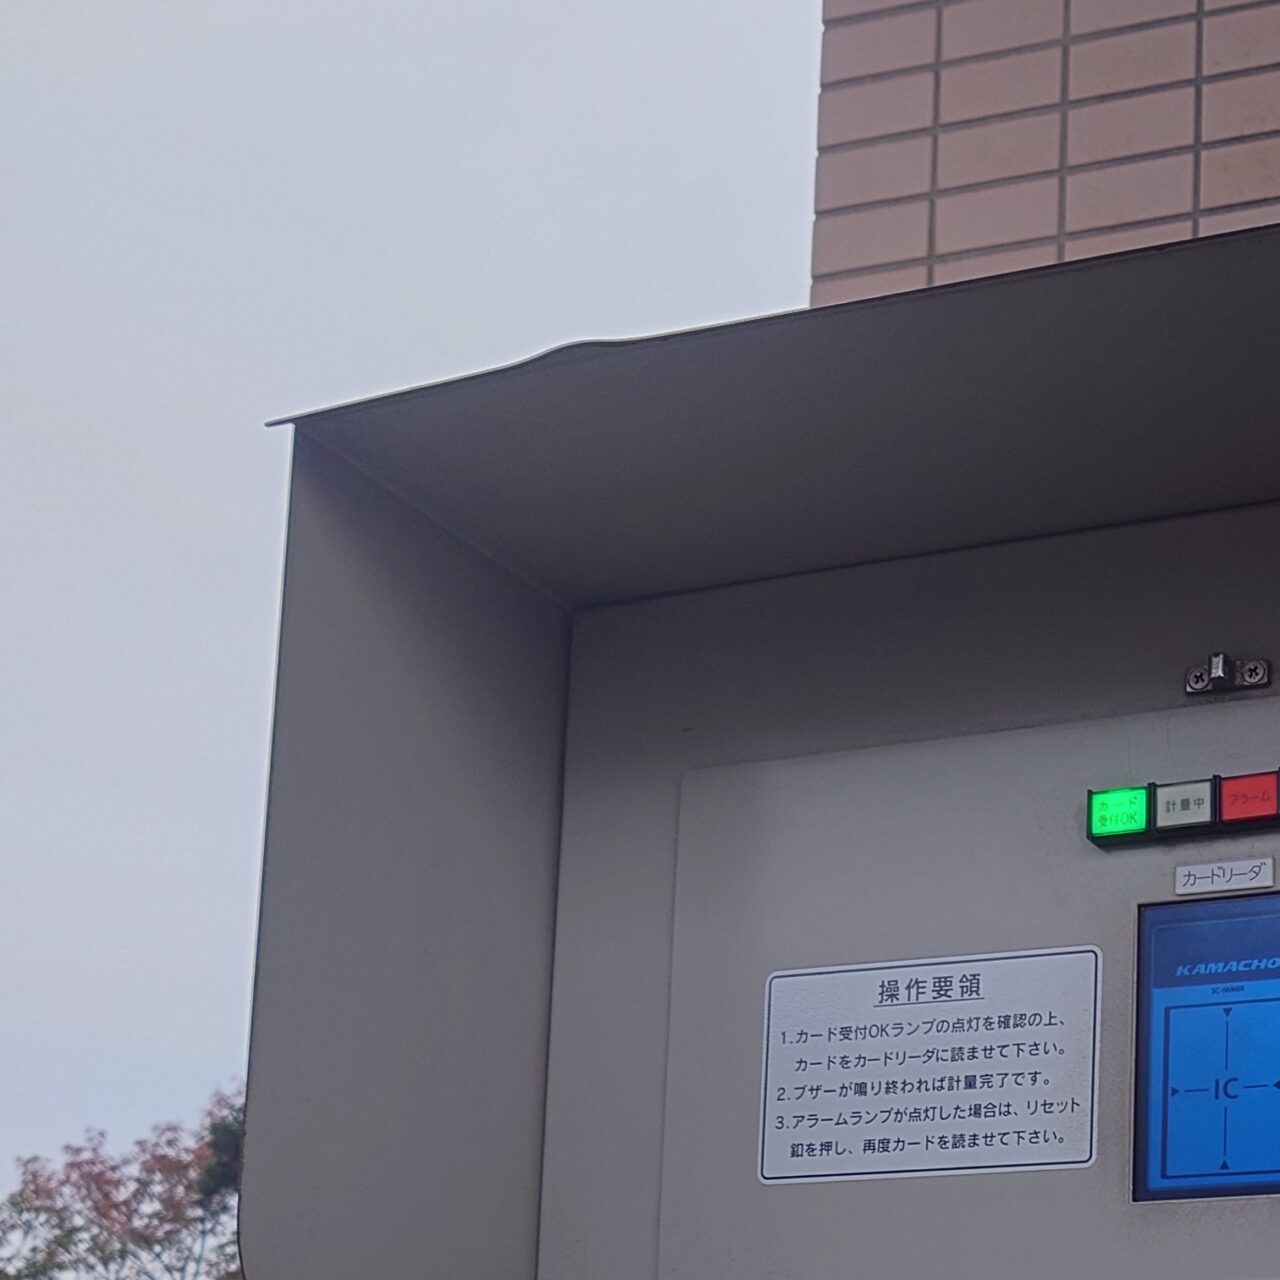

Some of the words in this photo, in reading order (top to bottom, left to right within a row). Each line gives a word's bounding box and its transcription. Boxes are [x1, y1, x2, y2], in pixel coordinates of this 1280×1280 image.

[1164, 797, 1205, 813] 計量中
[1229, 792, 1271, 805] アラーム
[1182, 861, 1266, 887] カードリーダ
[878, 973, 982, 1004] 操作要領
[795, 1041, 1065, 1072] カードをカードリーダに読ませて下さい。
[1214, 1077, 1240, 1100] IC
